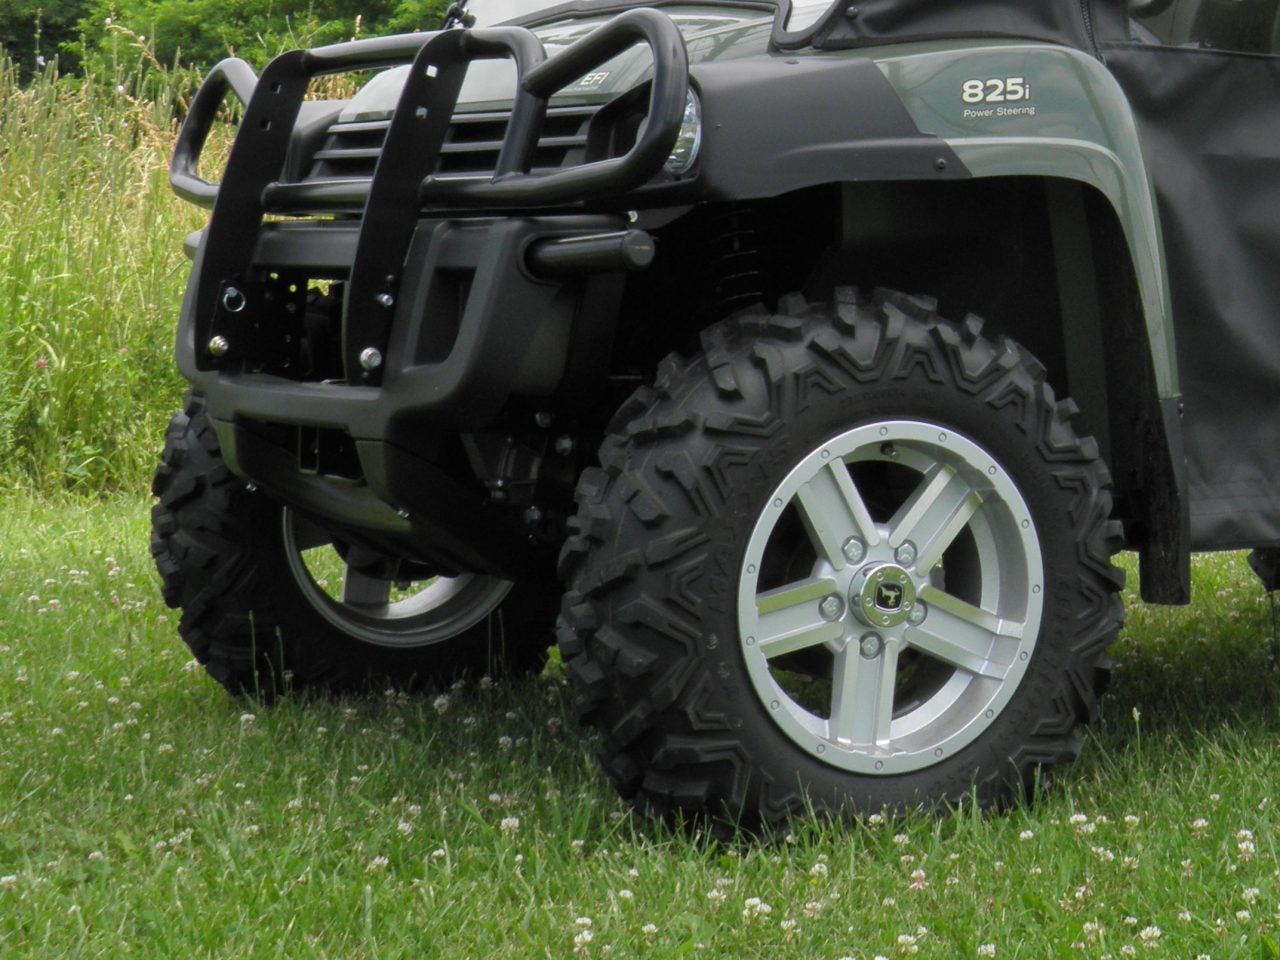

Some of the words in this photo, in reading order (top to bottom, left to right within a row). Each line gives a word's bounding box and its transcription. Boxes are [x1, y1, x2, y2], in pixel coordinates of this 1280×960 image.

[580, 71, 610, 86] EFI
[961, 77, 1030, 103] 825i
[963, 108, 994, 118] Power
[996, 106, 1036, 117] Steering
